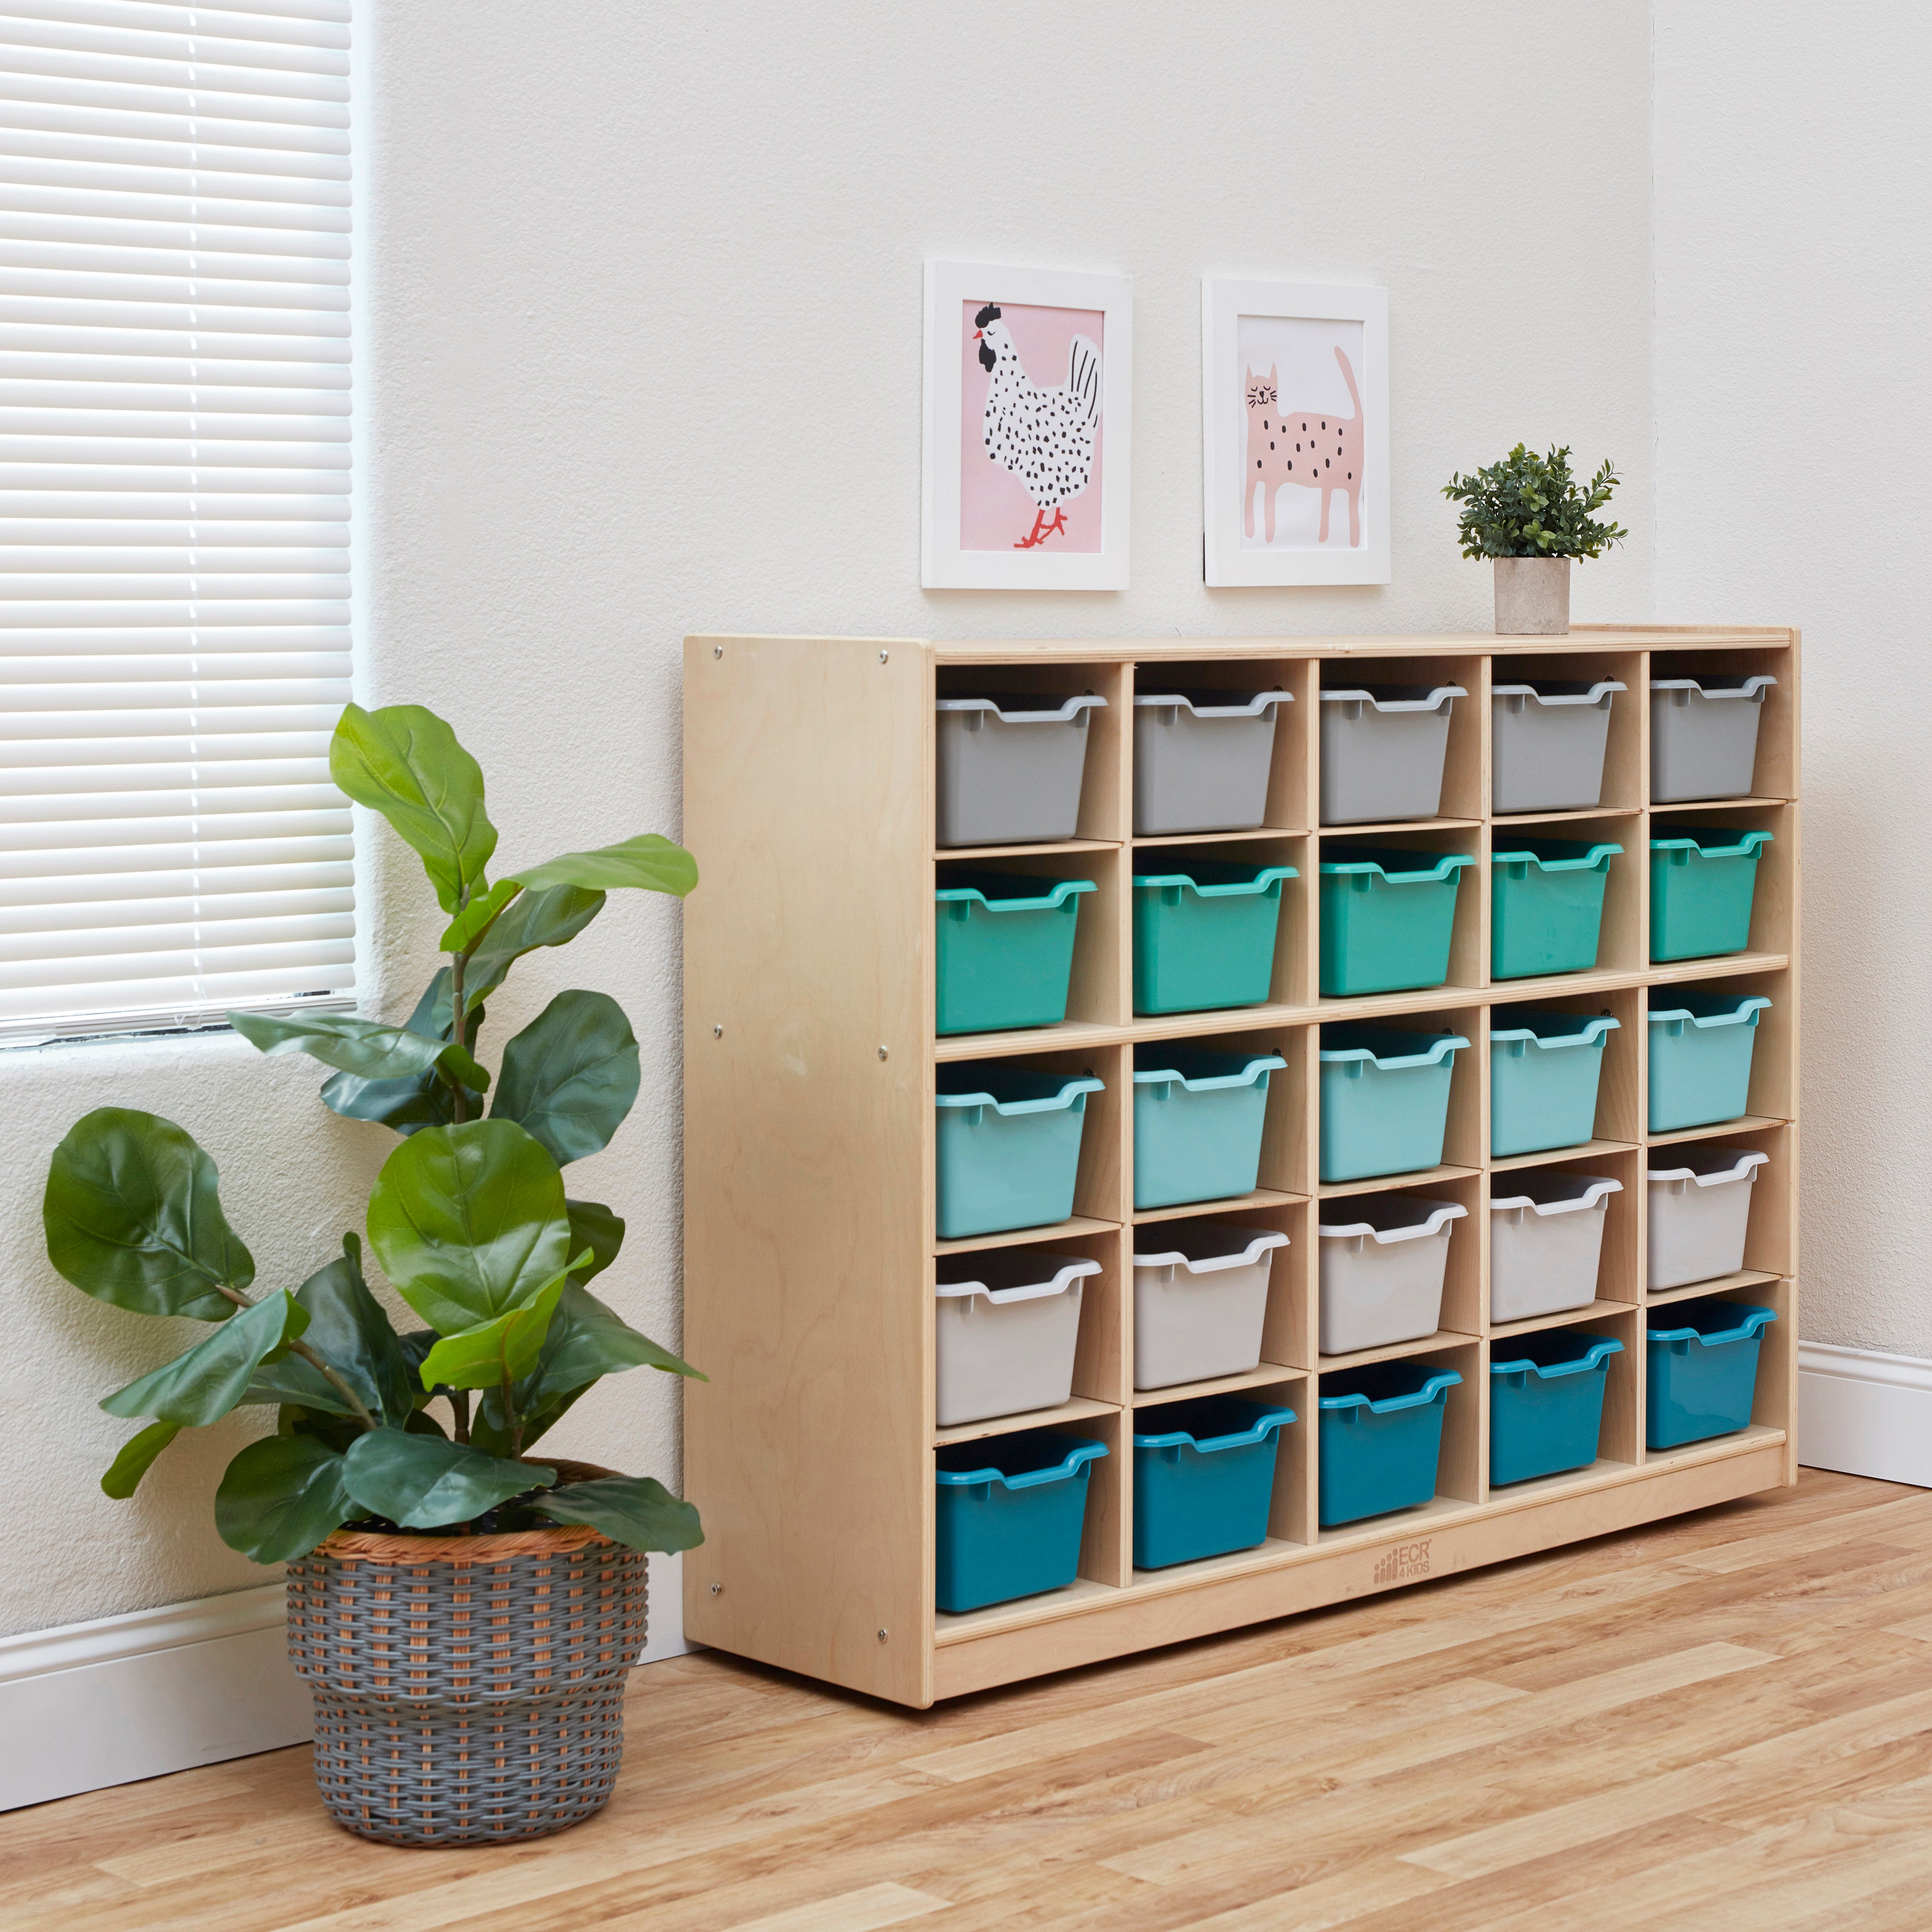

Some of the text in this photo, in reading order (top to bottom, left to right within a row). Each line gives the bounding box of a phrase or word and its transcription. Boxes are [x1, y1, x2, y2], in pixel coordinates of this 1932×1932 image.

[1399, 1541, 1430, 1565] ECR
[1399, 1561, 1430, 1579] 4 KIDS
